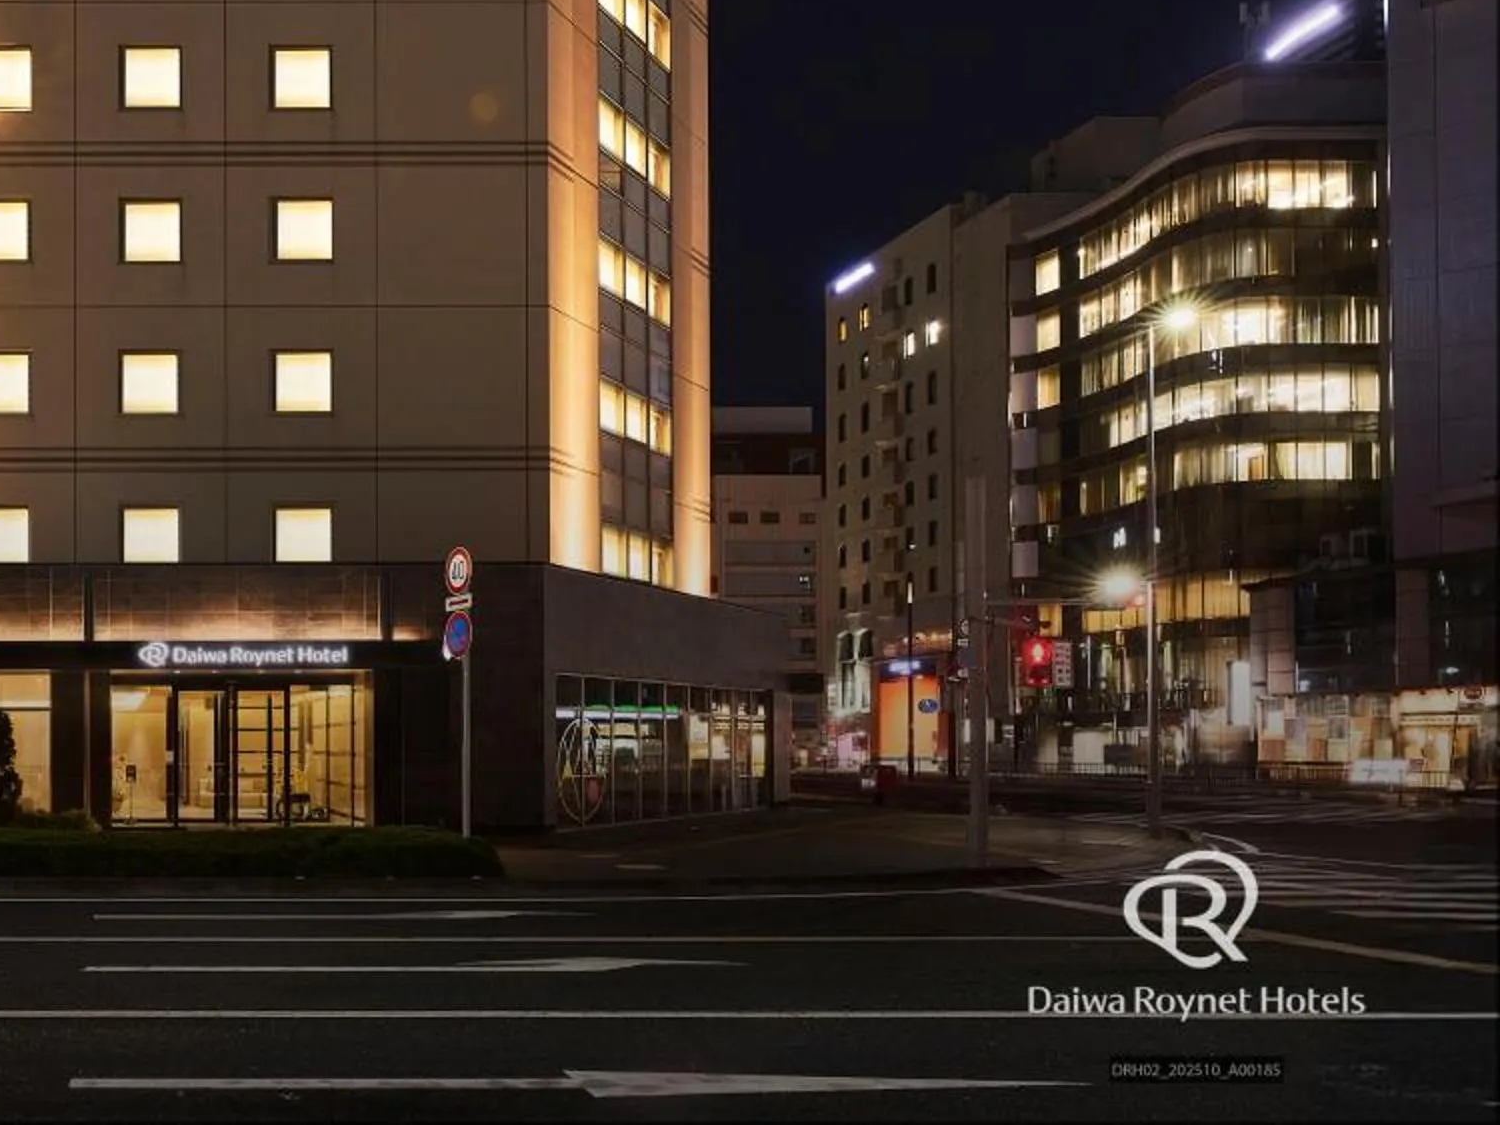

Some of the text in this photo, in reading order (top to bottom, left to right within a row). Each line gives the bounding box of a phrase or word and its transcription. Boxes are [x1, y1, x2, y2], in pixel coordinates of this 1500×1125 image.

[172, 646, 228, 664] Daiwa
[230, 645, 295, 666] Roynet
[297, 645, 348, 663] Hotel
